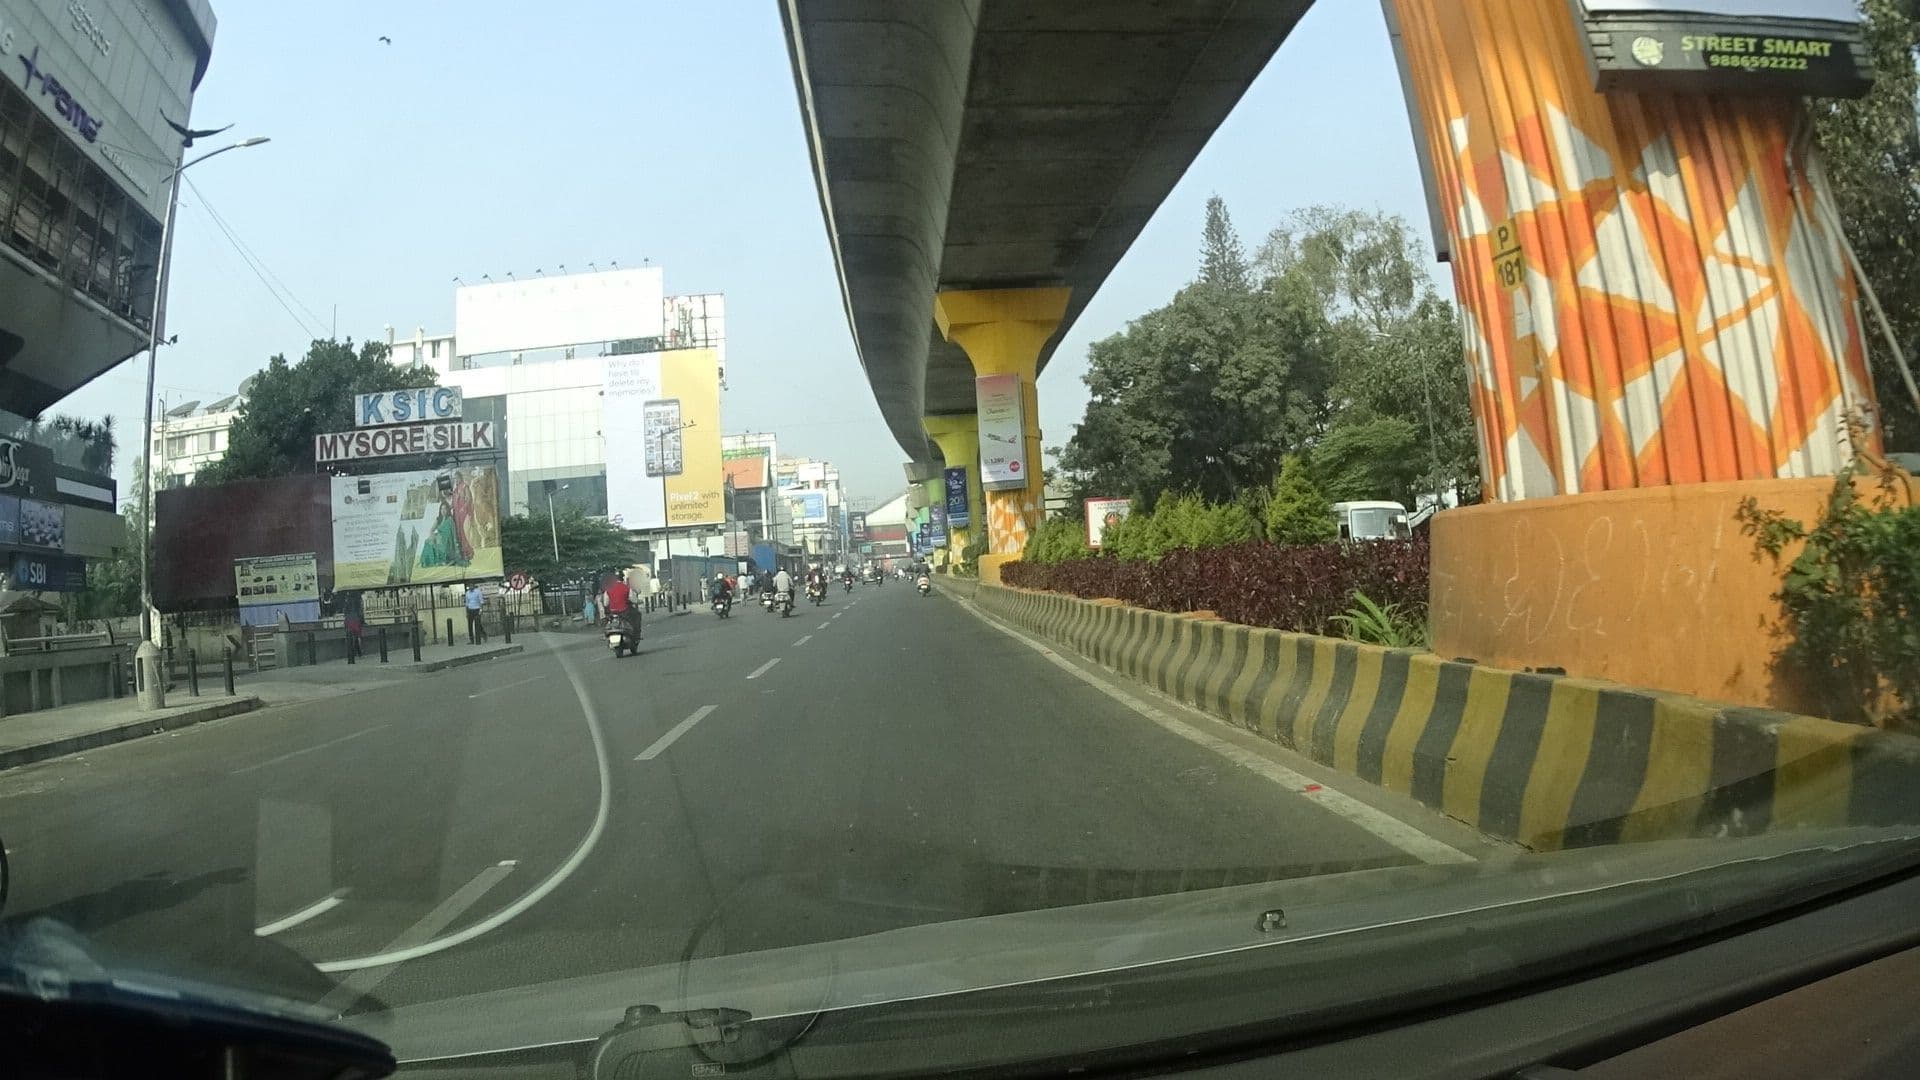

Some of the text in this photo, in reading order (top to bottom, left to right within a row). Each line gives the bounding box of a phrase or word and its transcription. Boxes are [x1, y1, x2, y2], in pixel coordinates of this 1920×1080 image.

[1681, 36, 1832, 57] STREET SMART
[1709, 54, 1808, 69] 9886592222
[1498, 226, 1509, 250] P
[1498, 257, 1523, 288] 181
[608, 378, 636, 388] delete
[362, 387, 454, 424] KSIC
[319, 422, 492, 460] MYSORE SILK
[670, 501, 709, 511] unlimited
[702, 490, 720, 500] with
[29, 562, 47, 585] SBI
